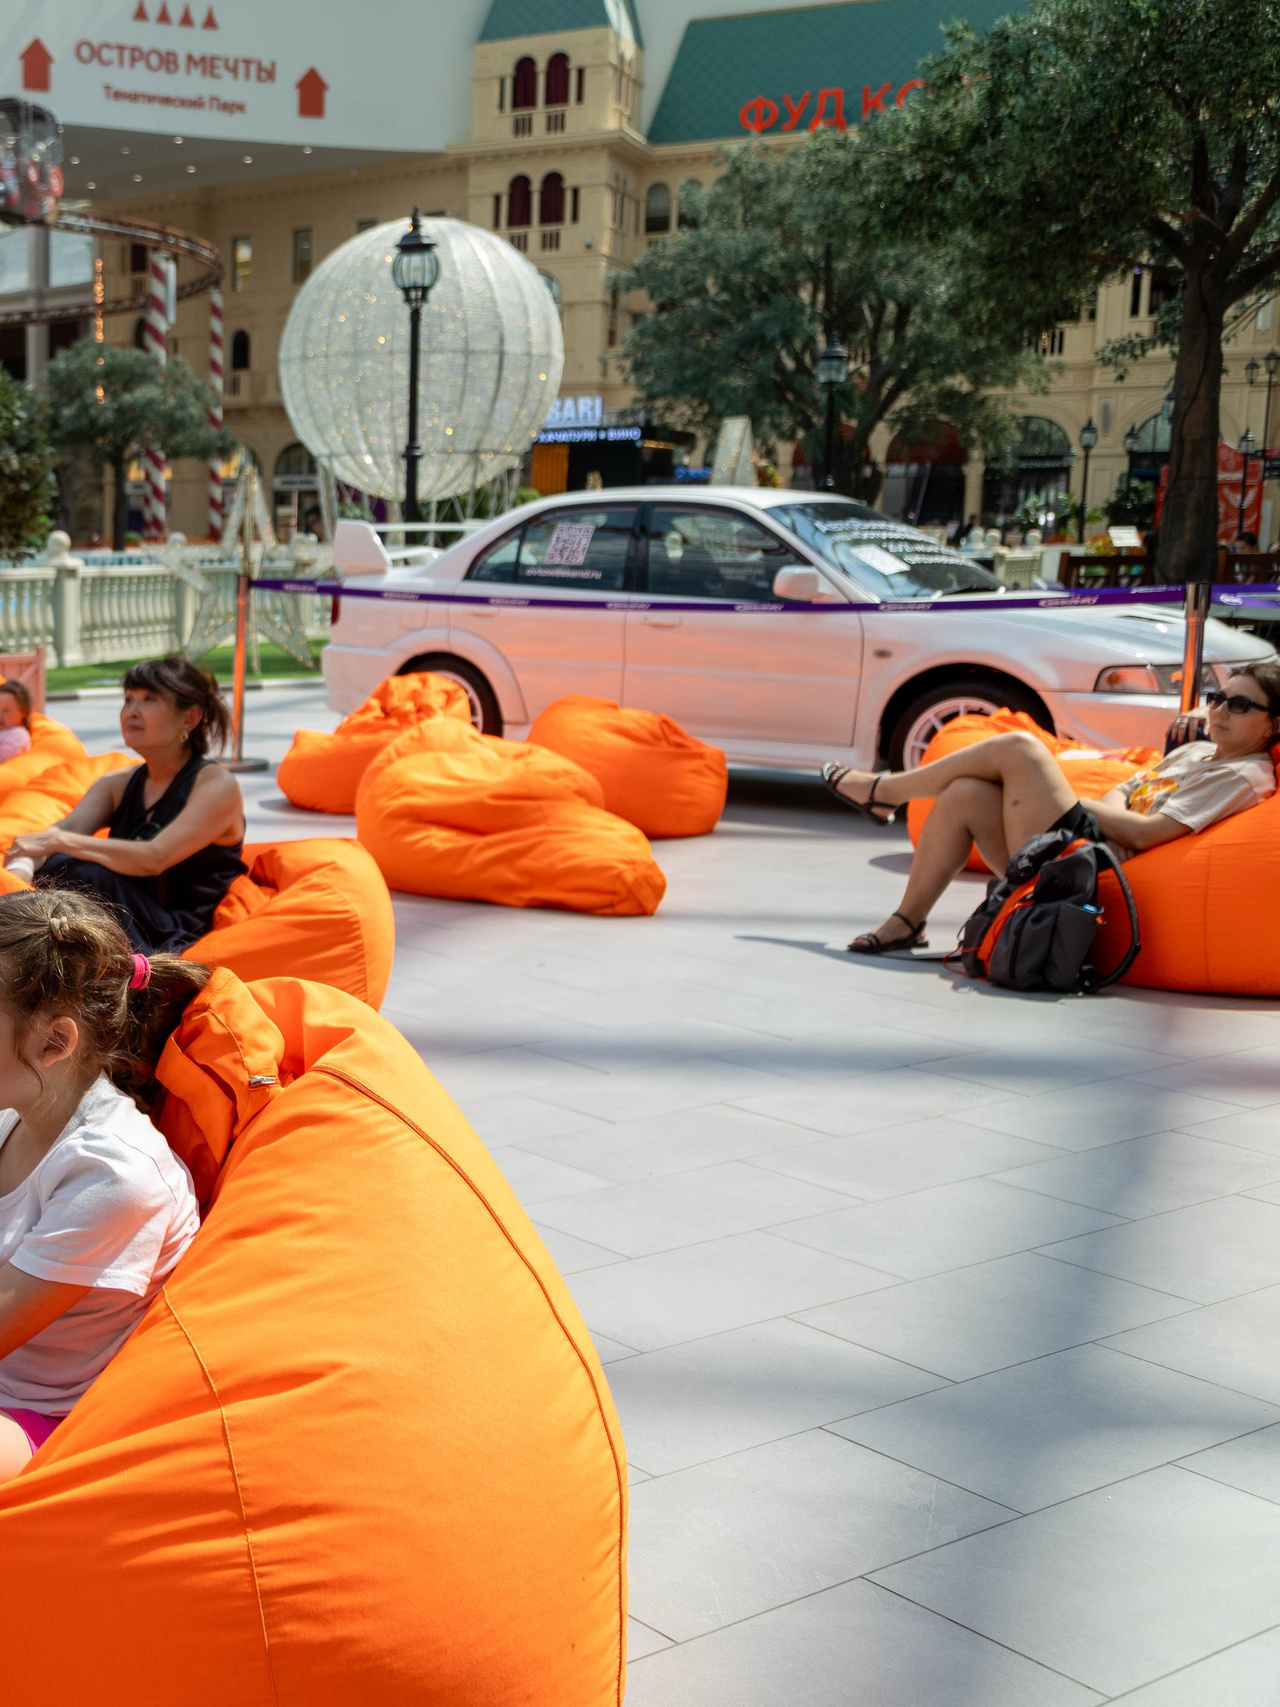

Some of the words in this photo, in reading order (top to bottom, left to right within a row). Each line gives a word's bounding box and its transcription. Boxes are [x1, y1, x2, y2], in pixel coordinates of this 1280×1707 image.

[75, 40, 180, 74] ОСТРОВ
[186, 53, 277, 84] МЕЧТЫ
[103, 84, 205, 110] Тематический
[209, 95, 247, 115] Парк
[739, 87, 846, 134] ФУД
[607, 427, 641, 441] ВИНО
